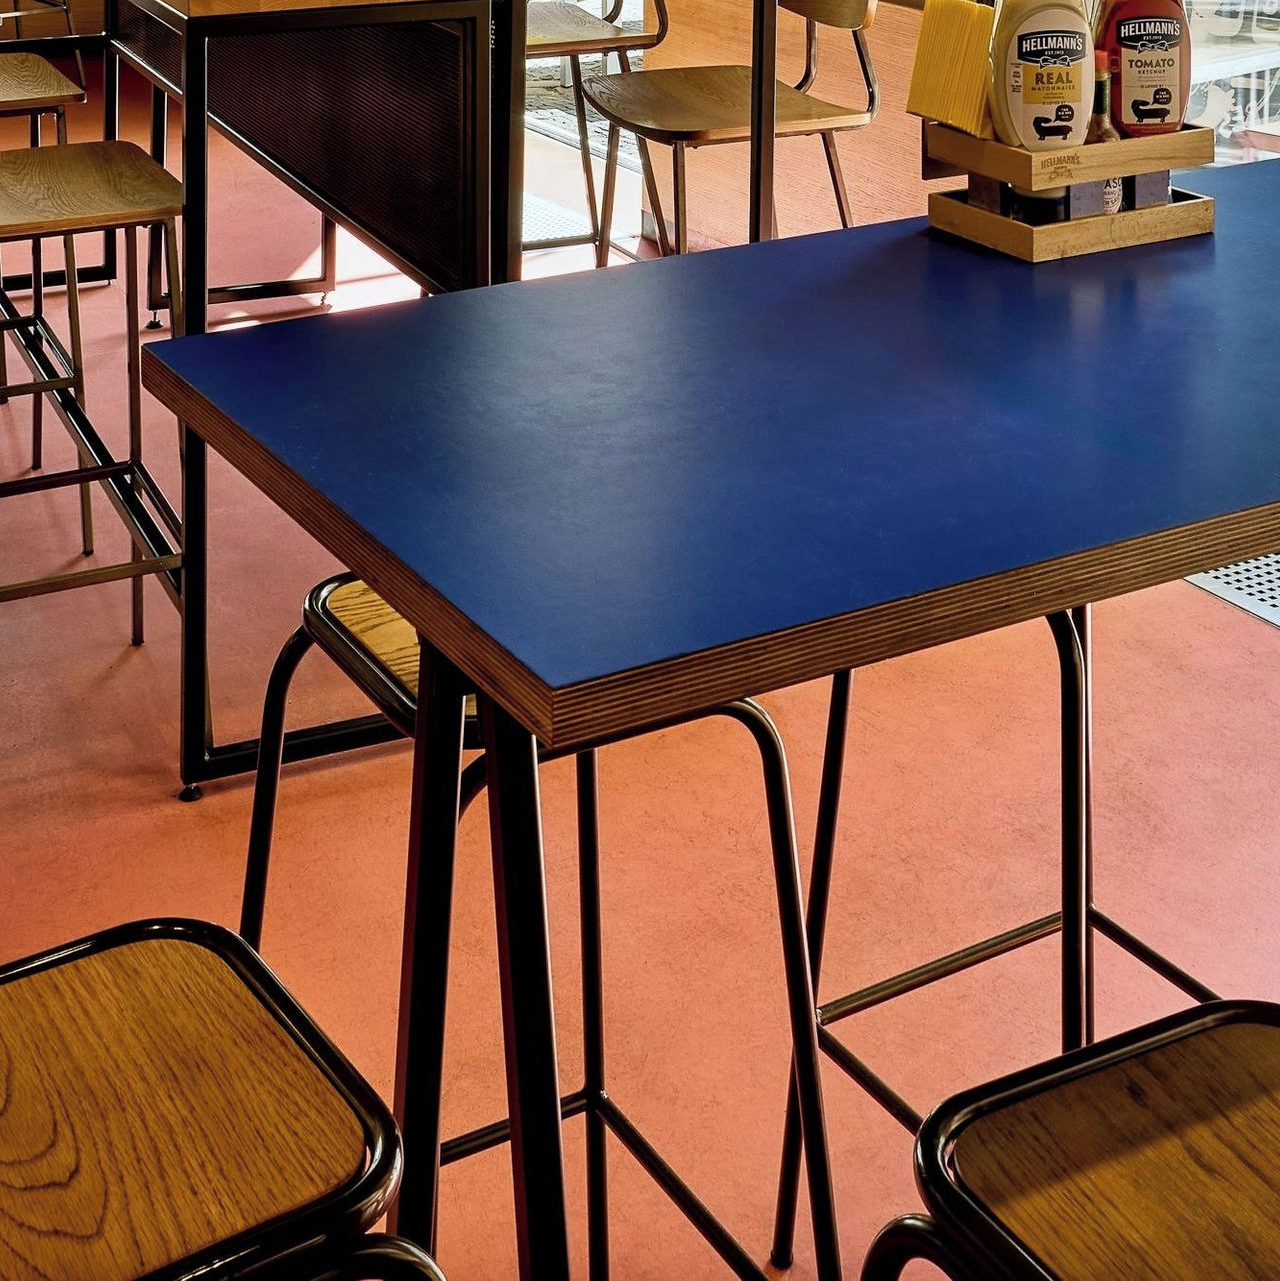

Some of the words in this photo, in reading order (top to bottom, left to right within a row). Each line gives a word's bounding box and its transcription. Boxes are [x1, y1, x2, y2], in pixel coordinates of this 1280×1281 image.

[1121, 20, 1180, 37] HELLMANN'S
[1022, 34, 1083, 52] HELLMANN'S
[1128, 58, 1175, 69] TOMATO
[1035, 71, 1073, 85] REAL
[1031, 84, 1075, 92] MAYONNAISE
[1041, 153, 1081, 170] HELLMANN'S
